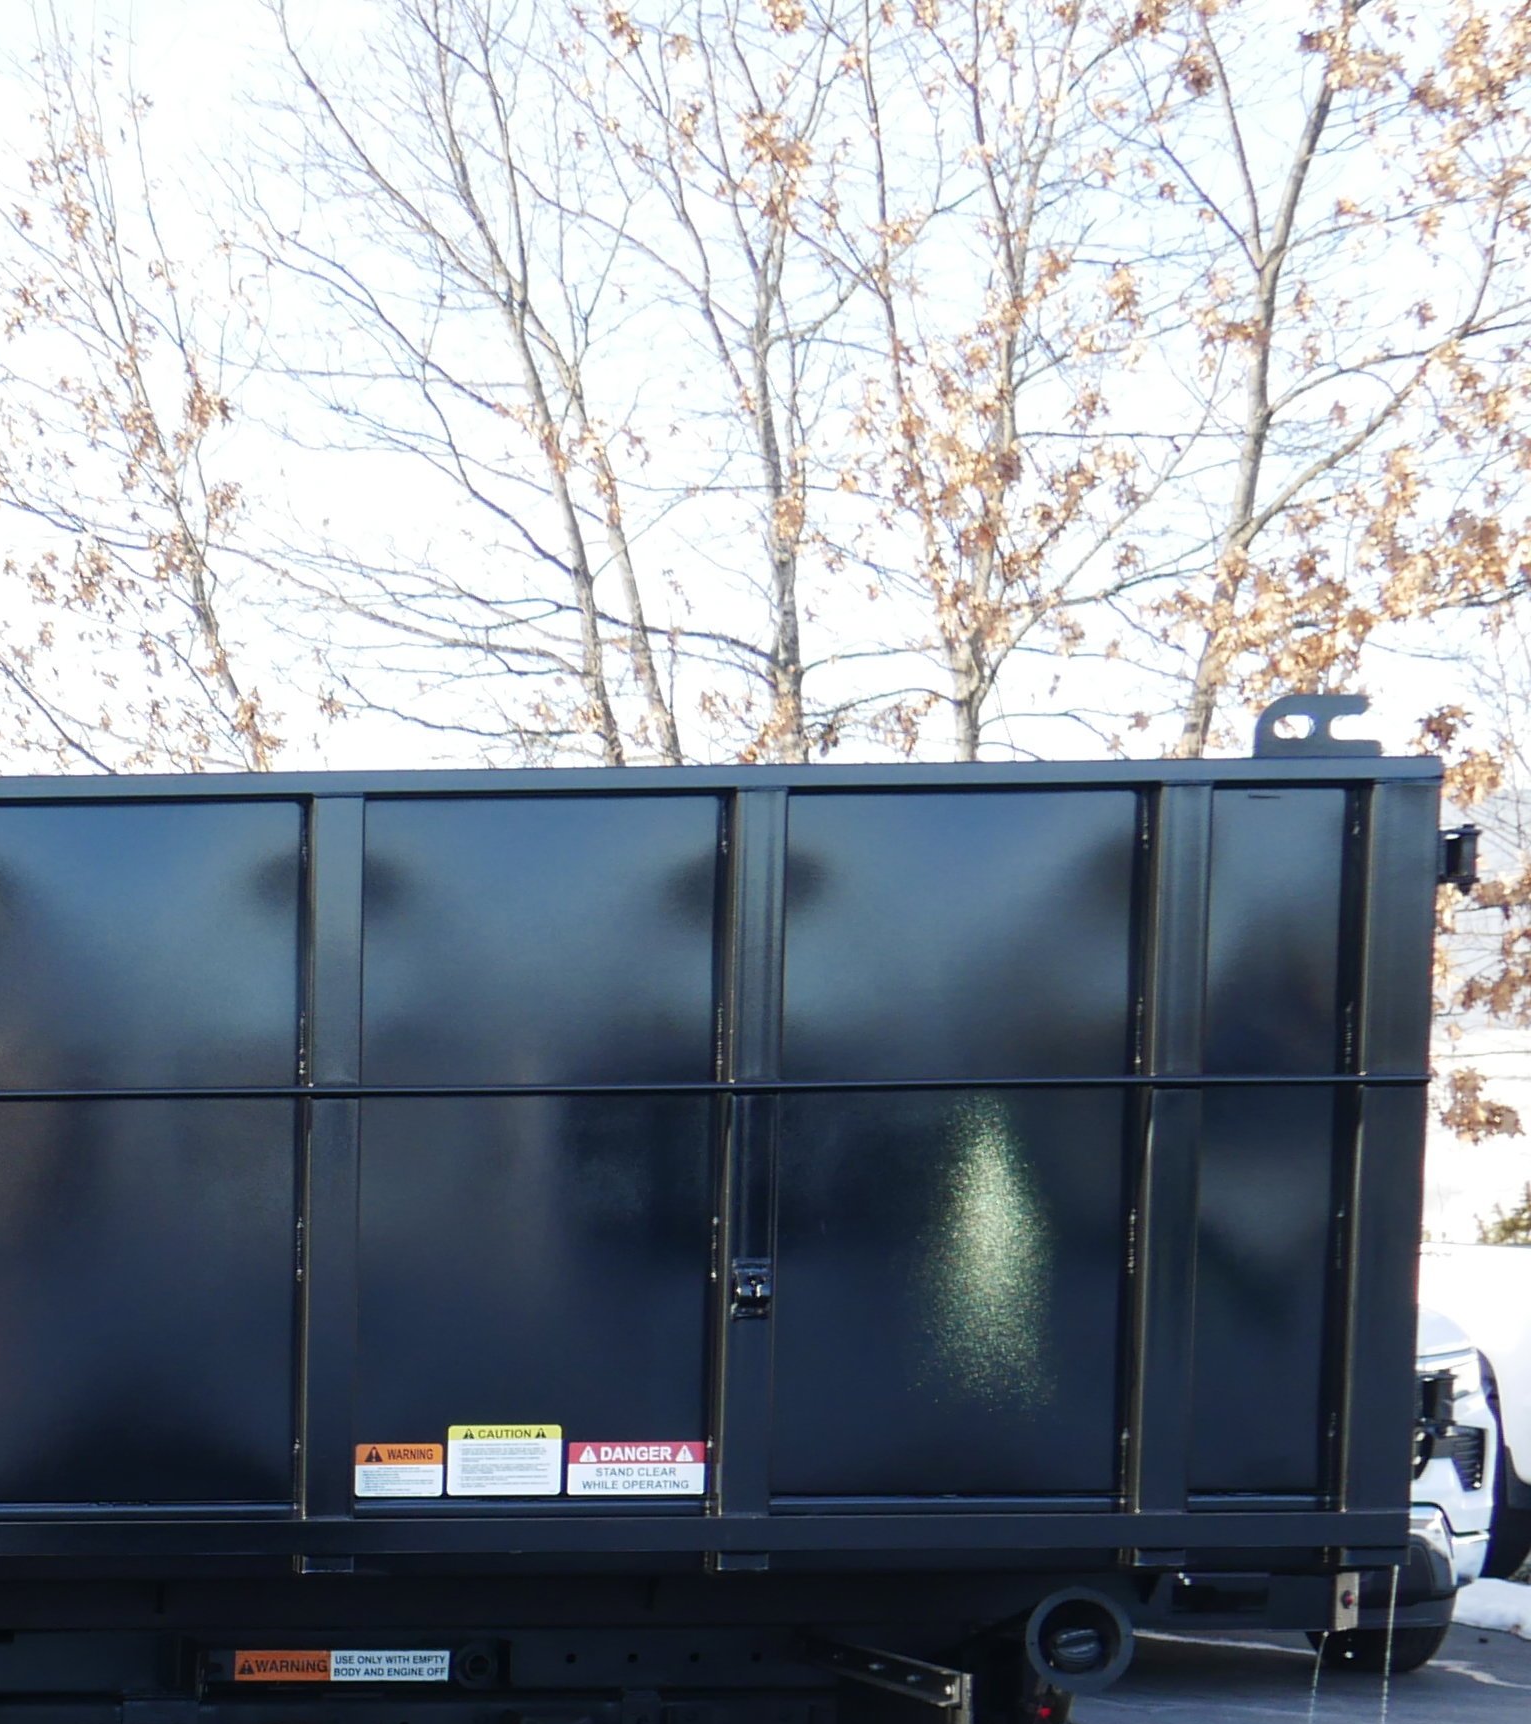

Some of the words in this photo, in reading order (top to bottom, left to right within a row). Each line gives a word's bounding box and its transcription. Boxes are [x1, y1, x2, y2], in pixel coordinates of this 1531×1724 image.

[478, 1429, 532, 1439] CAUTION
[387, 1448, 434, 1461] WARNING
[599, 1446, 672, 1461] DANGER
[595, 1467, 634, 1477] STAND
[637, 1467, 677, 1477] CLEAR
[581, 1480, 618, 1490] WHILE
[622, 1480, 690, 1490] OPERATING
[335, 1655, 355, 1665] USE
[357, 1655, 382, 1665] ONLY
[385, 1655, 410, 1665] WITH
[412, 1655, 446, 1664] EMPTY
[255, 1659, 329, 1673] WARNING
[333, 1667, 360, 1677] BODY
[363, 1667, 385, 1677] AND
[387, 1667, 424, 1677] ENGINE
[426, 1667, 447, 1676] OFF
